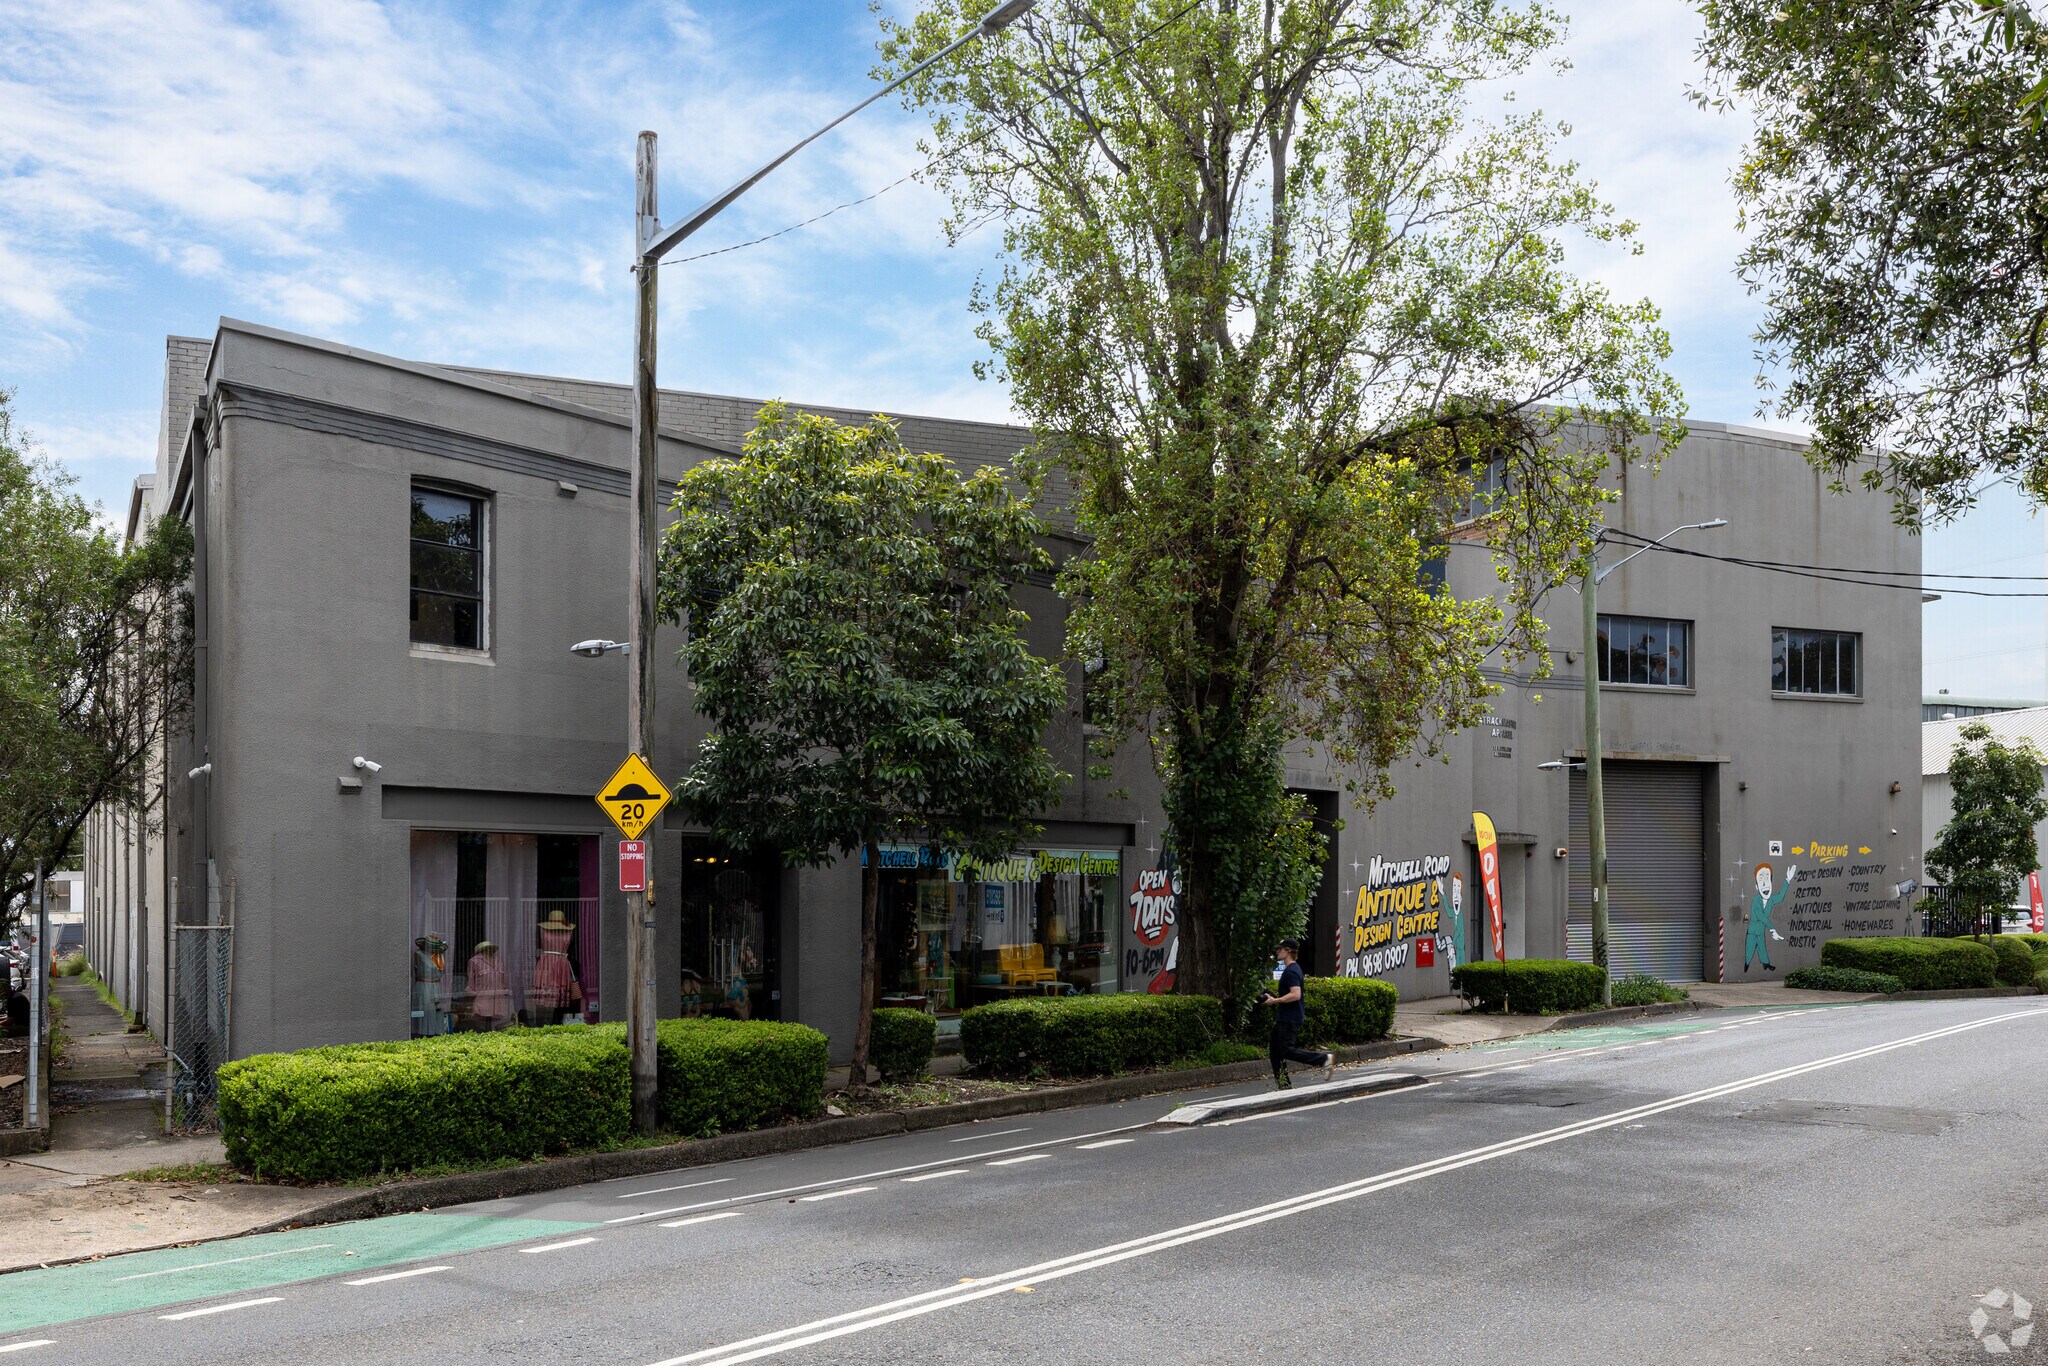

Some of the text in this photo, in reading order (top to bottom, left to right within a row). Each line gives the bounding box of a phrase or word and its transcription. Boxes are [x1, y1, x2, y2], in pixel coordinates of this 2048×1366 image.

[621, 803, 645, 820] 20
[622, 820, 643, 828] km/h
[627, 843, 638, 852] NO
[1810, 841, 1849, 858] PARKING
[1029, 858, 1040, 882] &
[1038, 850, 1079, 875] DESIGN
[1079, 851, 1119, 877] CENTRE
[1367, 854, 1450, 891] MITCHELL ROAD
[1817, 866, 1844, 879] DESIGN
[1851, 864, 1887, 877] COUNTRY
[1140, 869, 1168, 891] OPEN
[1795, 886, 1822, 899] RETRO
[1848, 882, 1869, 893] TOYS
[1354, 880, 1440, 927] ANTIQUE &
[1792, 902, 1832, 916] ANTIQUES
[1845, 900, 1901, 913] VINTAGE CLOTHING
[1354, 911, 1439, 953] DESIGN CENTRE
[1789, 919, 1833, 932] INDUSTRIAL
[1844, 919, 1894, 932] HOMEWARES
[1788, 936, 1816, 949] RUSTIC
[1126, 948, 1165, 978] 10-6PM
[1362, 950, 1383, 977] 9698
[1384, 943, 1409, 970] 0907
